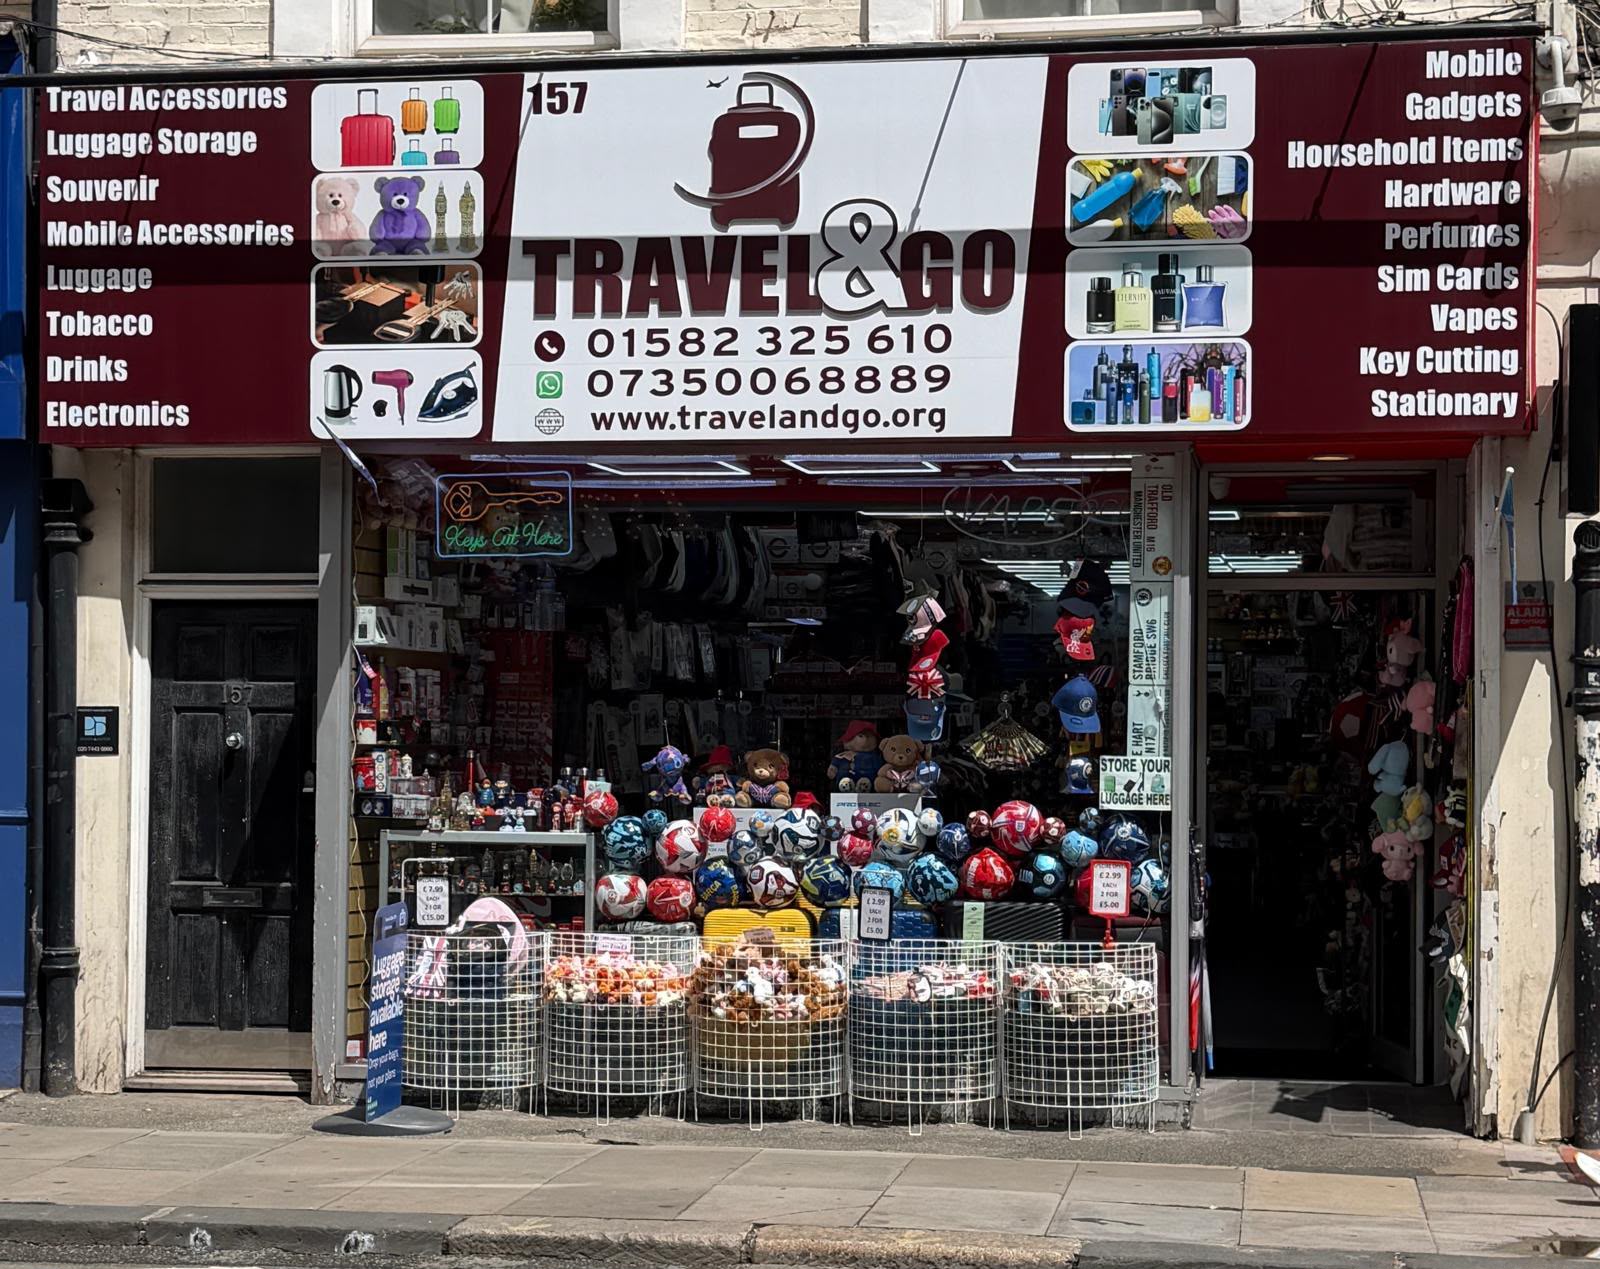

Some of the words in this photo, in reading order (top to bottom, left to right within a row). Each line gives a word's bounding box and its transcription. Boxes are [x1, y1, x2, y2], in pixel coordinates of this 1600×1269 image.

[1426, 49, 1523, 79] Mobile
[46, 86, 125, 112] Travel
[129, 86, 288, 111] Accessories
[528, 81, 588, 115] 157
[1405, 91, 1523, 122] Gadgets
[46, 130, 152, 158] Luggage
[158, 128, 257, 157] Storage
[1288, 137, 1436, 169] Household
[1442, 135, 1523, 163] Items
[46, 175, 159, 202] Souvenir
[1385, 178, 1521, 209] Hardware
[47, 221, 132, 246] Mobile
[137, 219, 294, 245] Accessories
[1385, 222, 1520, 250] Perfumes
[46, 265, 153, 294] Luggage
[1377, 265, 1430, 293] Sim
[1436, 263, 1519, 290] Cards
[46, 311, 153, 337] Tobacco
[1430, 304, 1517, 334] Vapes
[588, 326, 739, 359] 01582
[755, 325, 850, 357] 325
[867, 323, 952, 355] 610
[46, 355, 128, 382] Drinks
[1360, 348, 1410, 378] Key
[1416, 347, 1519, 377] Cutting
[587, 365, 951, 398] 07350068889
[46, 401, 190, 428] Electronics
[590, 403, 946, 434] www.travelandgo.org
[1371, 390, 1517, 419] Stationary
[1161, 484, 1173, 501] OLD
[1132, 490, 1143, 540] MANCHESTER
[1146, 485, 1159, 530] TRAFFORD
[445, 525, 487, 552] Keys
[492, 525, 520, 547] Cut
[522, 520, 563, 546] Here
[1132, 541, 1142, 568] UNITED
[1146, 619, 1157, 640] SW6
[1133, 628, 1144, 680] STAMFORD
[222, 684, 254, 704] 157
[1131, 722, 1143, 747] HART
[1144, 736, 1156, 754] N17
[1101, 759, 1137, 772] STORE
[1140, 758, 1170, 773] YOUR
[1100, 793, 1144, 805] LUGGAGE
[1146, 793, 1170, 806] HERE
[373, 950, 405, 980] Luggage
[371, 976, 400, 1003] storage
[370, 996, 404, 1028] available
[368, 1030, 388, 1053] here
